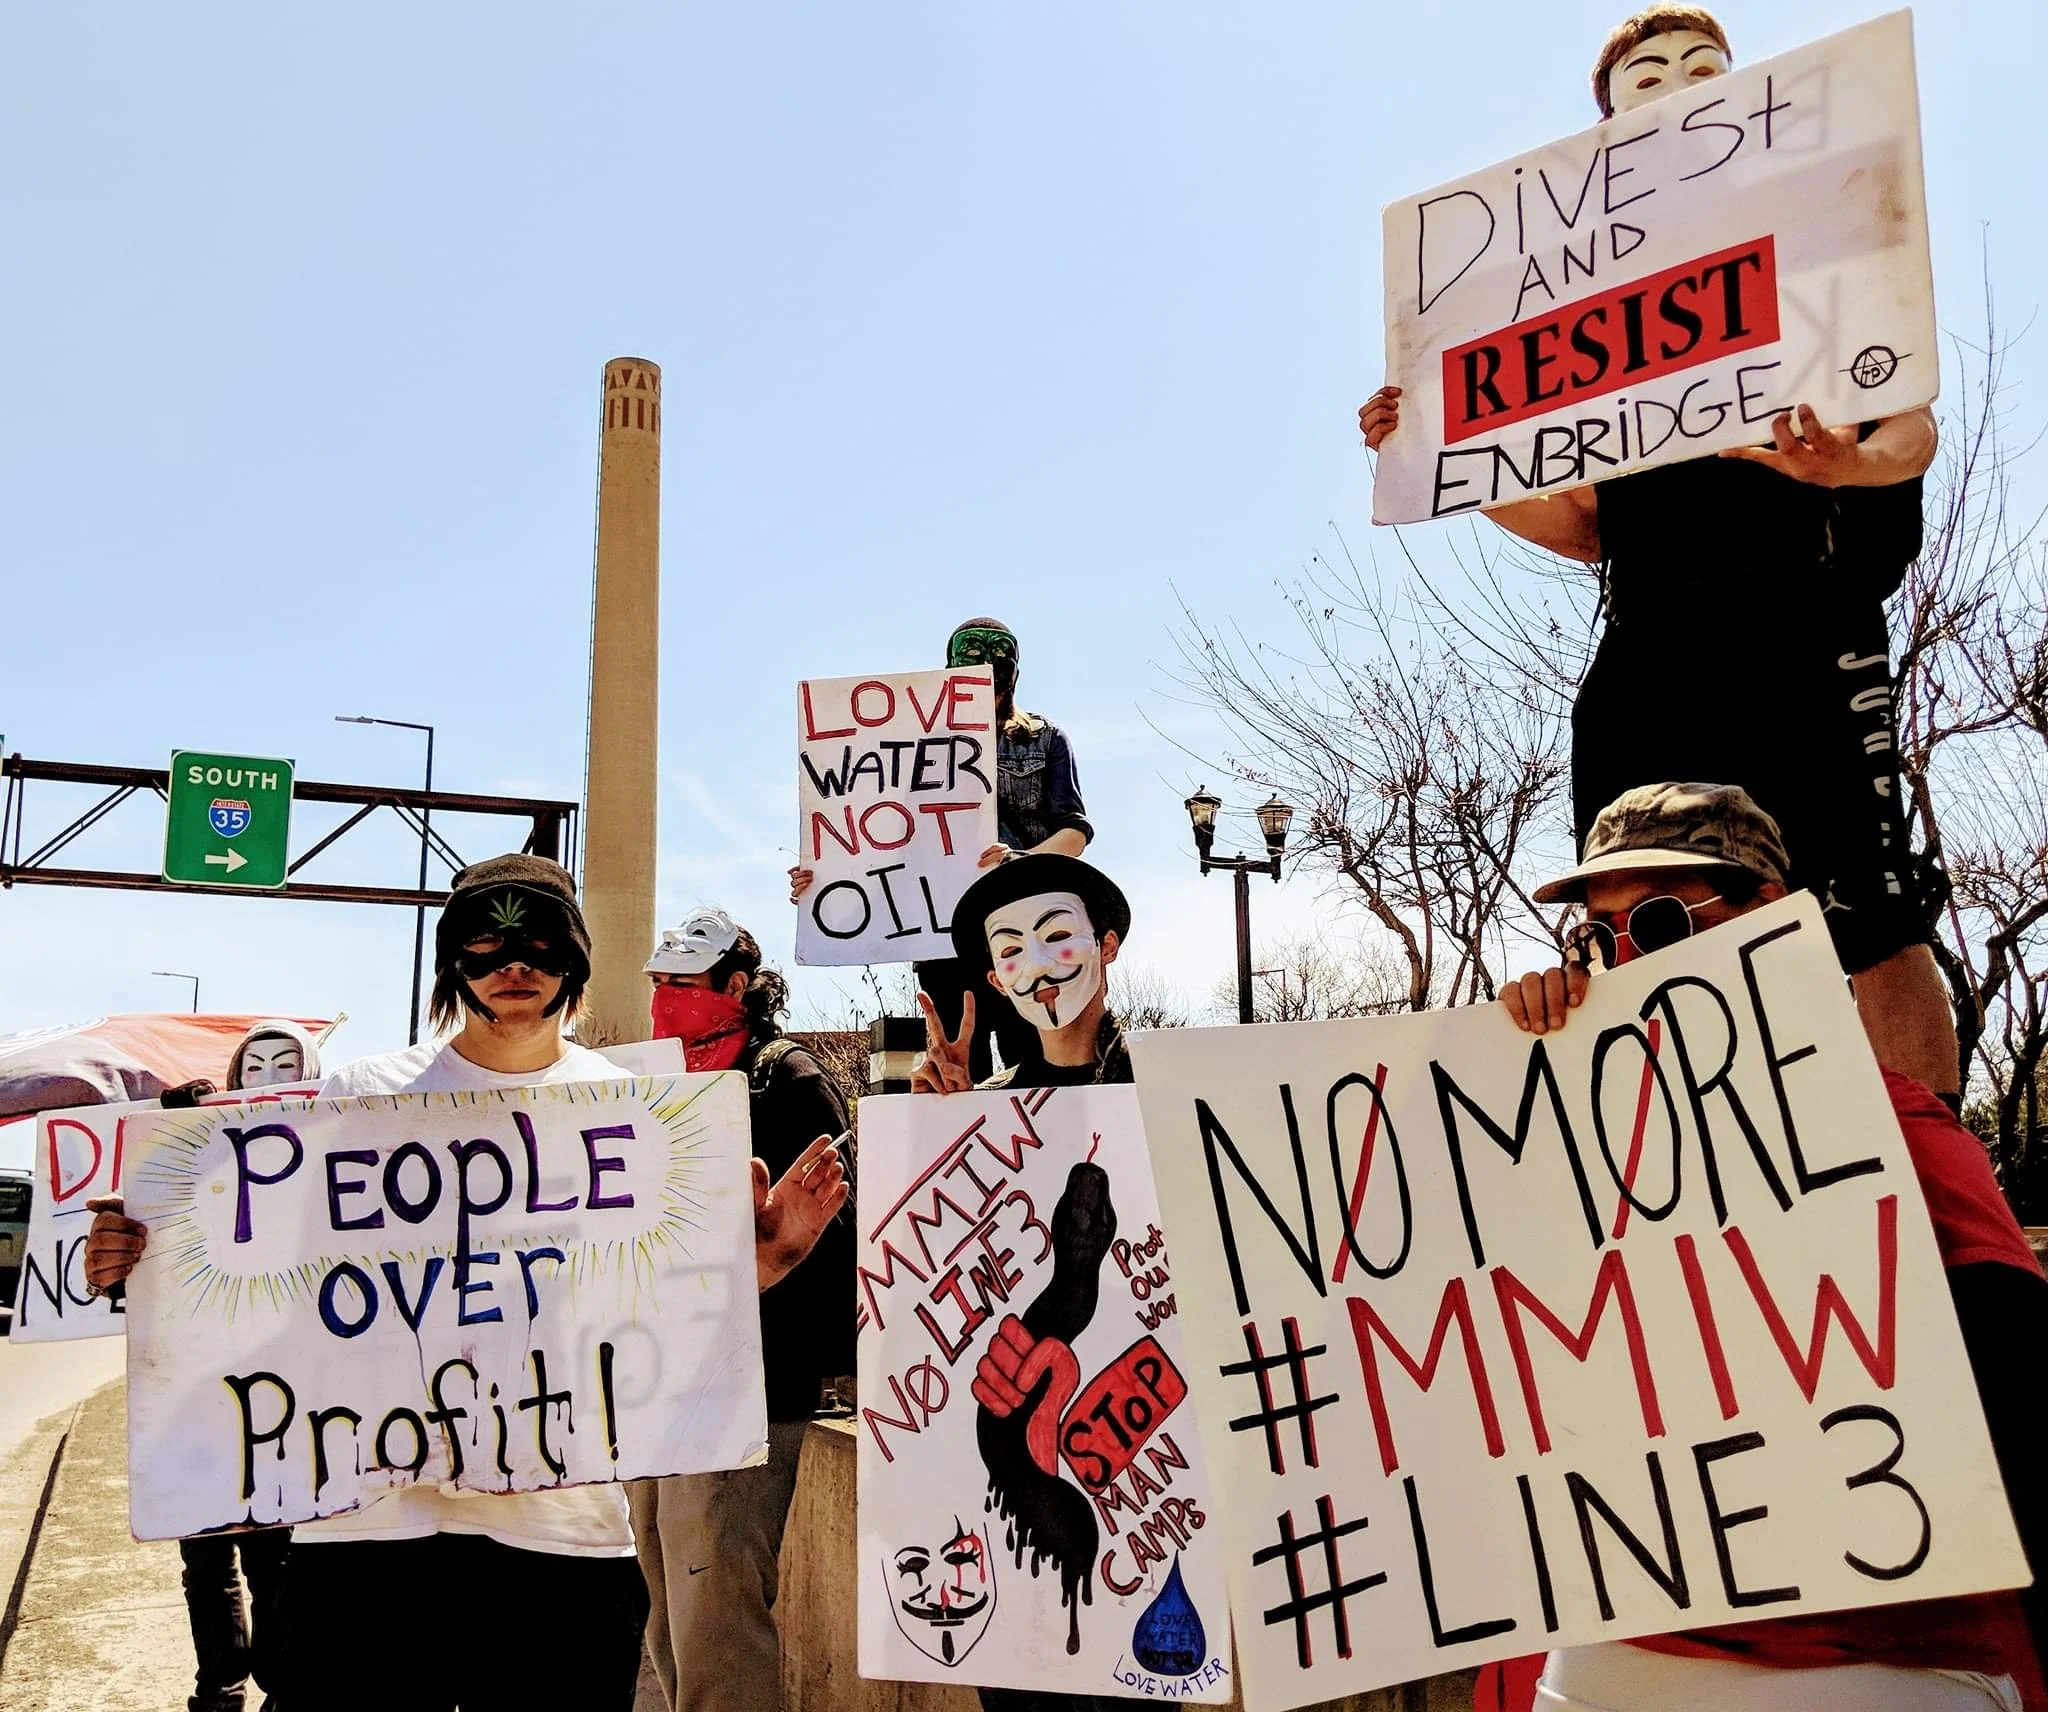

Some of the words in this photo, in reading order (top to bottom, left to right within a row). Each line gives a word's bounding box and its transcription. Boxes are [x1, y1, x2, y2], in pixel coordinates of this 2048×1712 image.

[1512, 223, 1646, 322] AND
[1460, 251, 1762, 425] RESIST
[801, 676, 992, 742] LOVE
[188, 766, 277, 790] SOUTH
[800, 735, 992, 799] WATER
[215, 810, 244, 829] 35
[812, 801, 981, 861] NOT
[812, 863, 952, 940] OIL
[1219, 1193, 1897, 1479] #MMIW
[1094, 1432, 1190, 1537] MAN
[1252, 1430, 1801, 1669] #LINE
[1818, 1404, 1933, 1580] 3
[1112, 1654, 1157, 1696] LOVE
[1159, 1658, 1230, 1698] WATER
